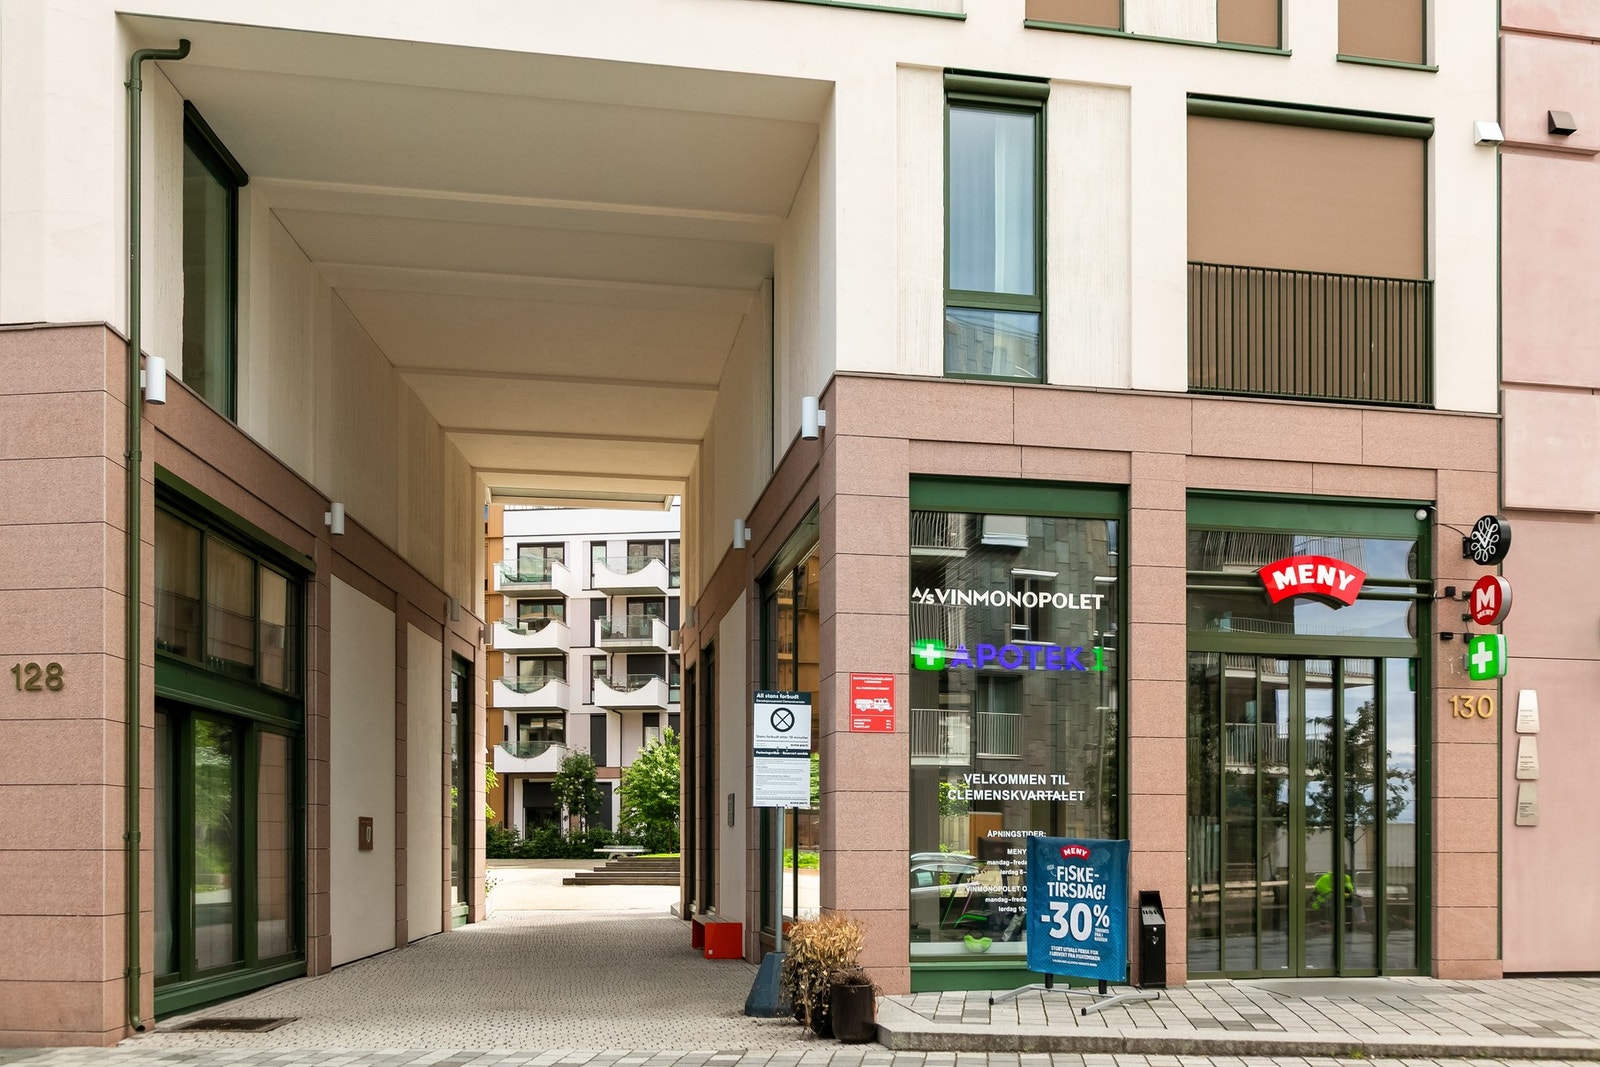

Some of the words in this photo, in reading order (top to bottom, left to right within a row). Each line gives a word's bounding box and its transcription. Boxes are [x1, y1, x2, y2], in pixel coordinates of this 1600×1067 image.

[1272, 564, 1356, 591] MENY
[935, 588, 1105, 610] VINMONOPOLET
[1476, 584, 1495, 613] M
[951, 642, 1087, 672] APOTEK
[1091, 646, 1108, 672] 1
[10, 662, 64, 691] 128
[1448, 695, 1494, 719] 130
[963, 774, 1046, 785] VELKOMMEN
[1050, 775, 1070, 785] TIL
[947, 790, 1086, 801] CLEMENSKVARTALET
[1063, 847, 1088, 857] MENY
[1056, 865, 1100, 883] FISKE-
[966, 885, 1020, 893] VINMONOPOLET
[1046, 881, 1107, 901] TIRSDAG!
[1041, 901, 1110, 942] -30%
